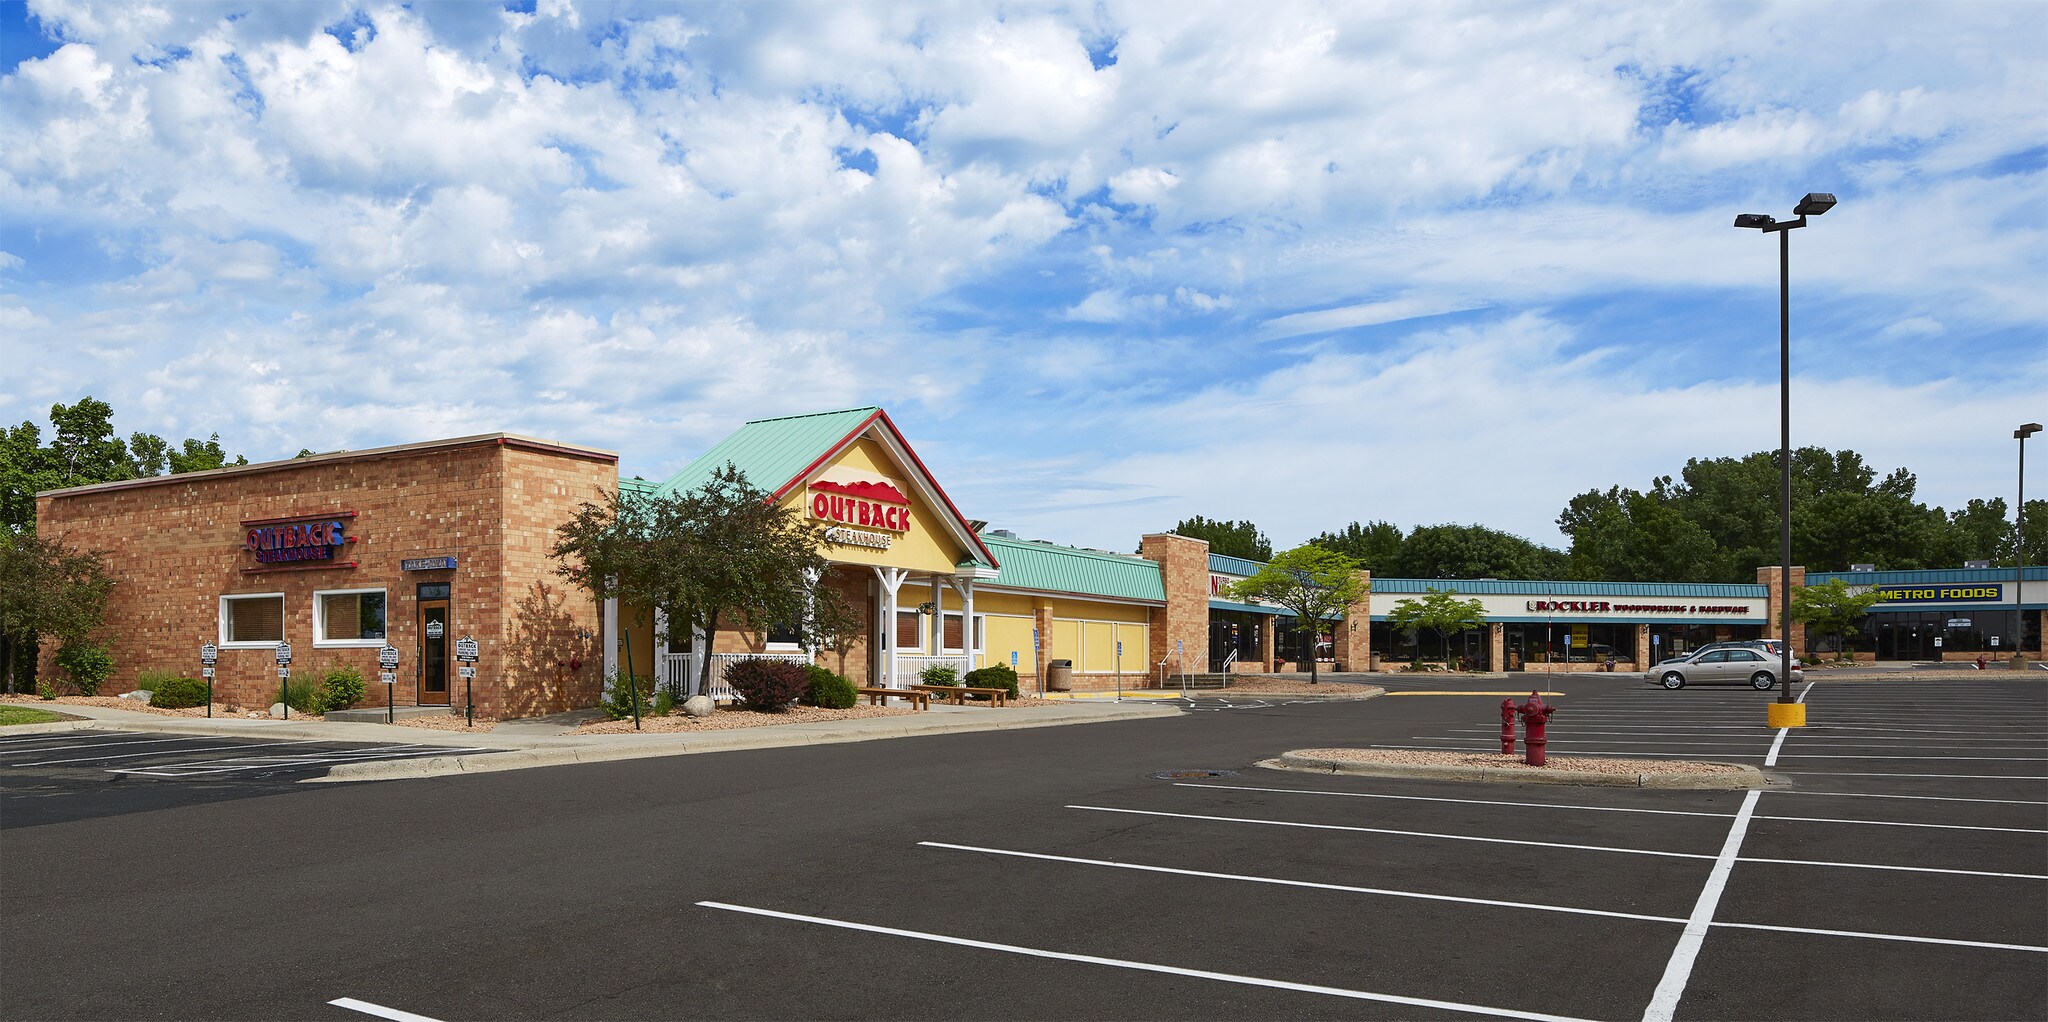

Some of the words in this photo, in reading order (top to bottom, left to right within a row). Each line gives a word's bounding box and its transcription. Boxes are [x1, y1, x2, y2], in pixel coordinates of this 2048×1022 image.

[814, 493, 910, 531] OUTBACK
[246, 523, 340, 551] OUTBACK
[836, 529, 891, 545] STEAKHOUSE
[255, 547, 327, 563] STEAKHOUSE
[1880, 589, 1935, 599] METRO
[1940, 588, 1998, 598] FOODS
[1536, 601, 1611, 612] ROCKLER
[1613, 604, 1687, 612] WOODWORKING
[1698, 605, 1750, 613] HARDWARE
